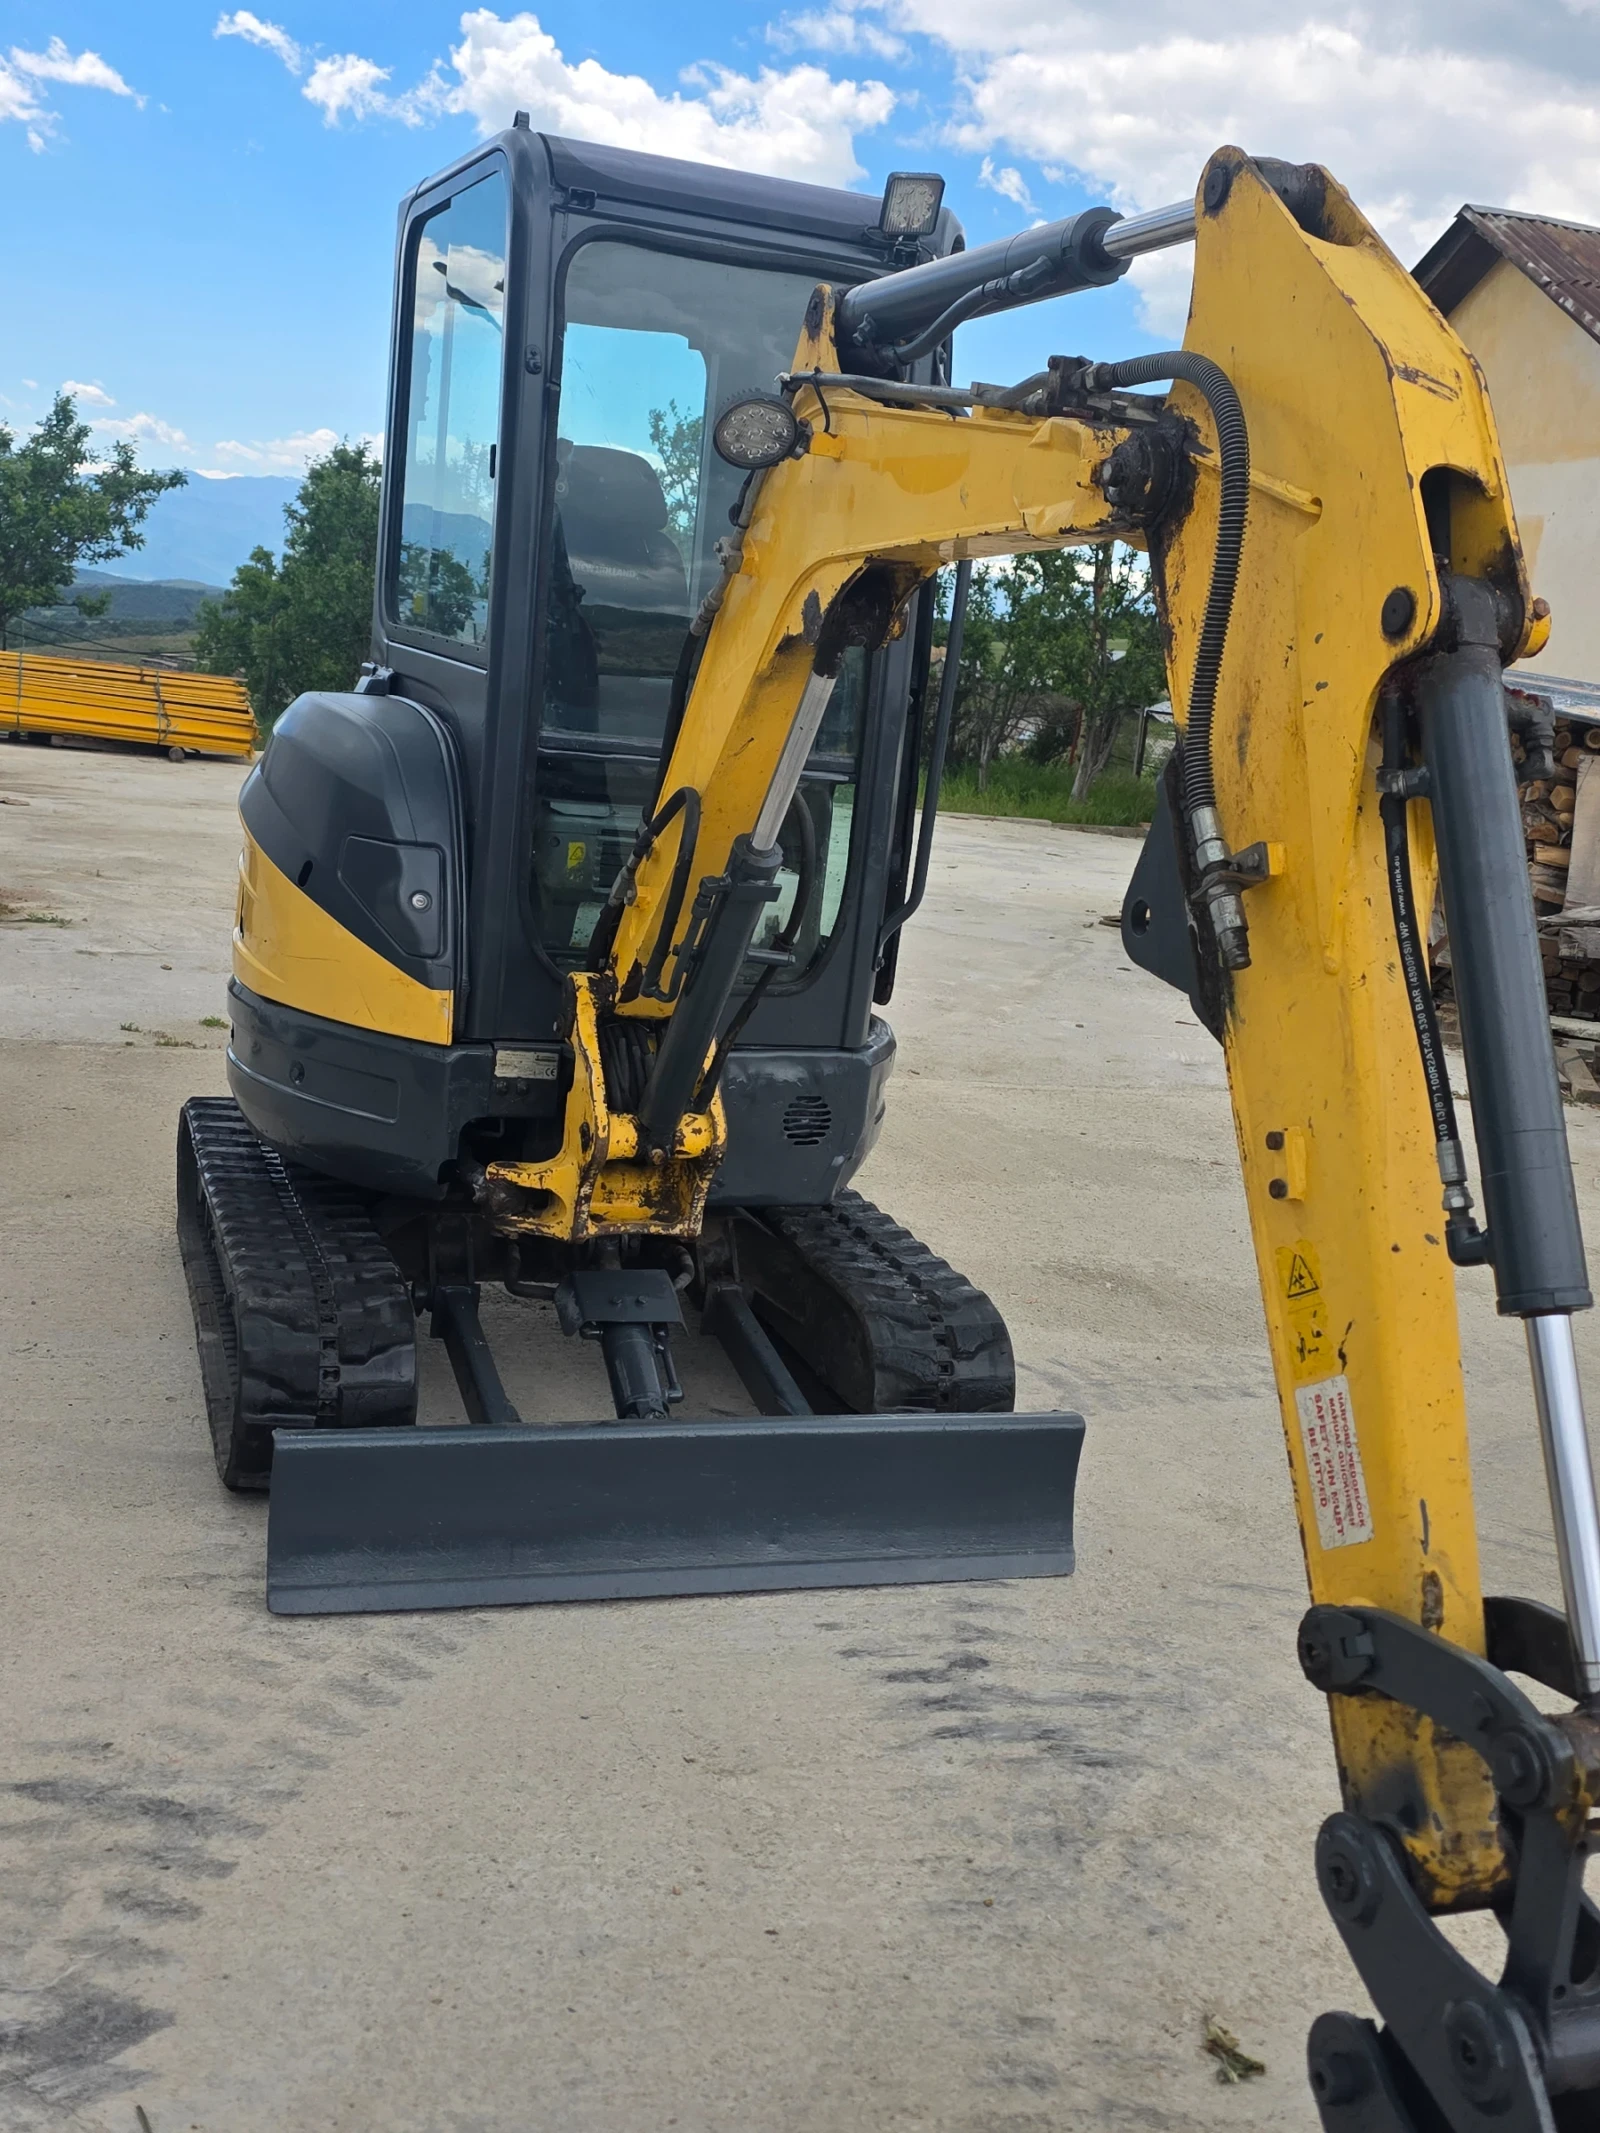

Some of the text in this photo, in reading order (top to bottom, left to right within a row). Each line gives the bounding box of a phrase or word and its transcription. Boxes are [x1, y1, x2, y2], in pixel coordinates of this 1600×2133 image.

[1399, 921, 1410, 939] WP
[1402, 940, 1420, 986] (4800PSI)
[1412, 988, 1424, 1011] BAR
[1417, 1012, 1428, 1031] 330
[1422, 1032, 1440, 1091] 100R2AT-06
[1307, 1426, 1328, 1508] BE FITTED
[1314, 1393, 1345, 1535] SAFETY PIN MUST
[1328, 1397, 1355, 1527] MANUAL QUICKHITCH
[1337, 1391, 1366, 1528] HARFORD WEDGELOCK
